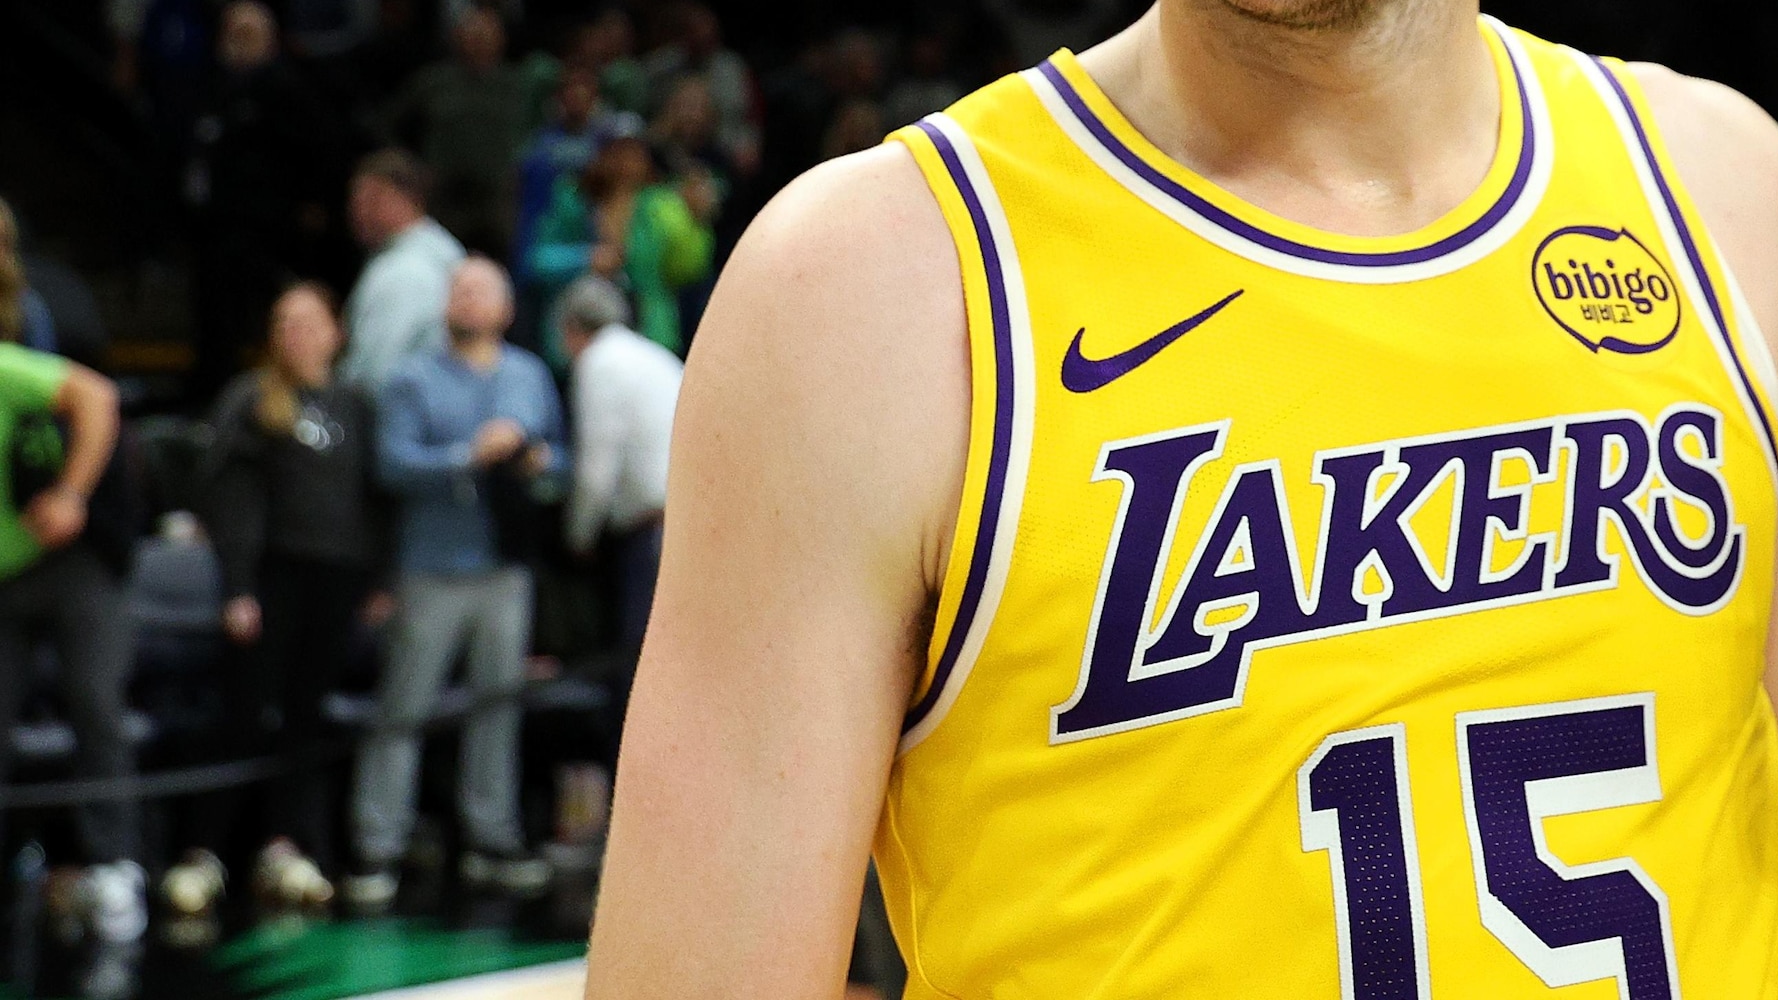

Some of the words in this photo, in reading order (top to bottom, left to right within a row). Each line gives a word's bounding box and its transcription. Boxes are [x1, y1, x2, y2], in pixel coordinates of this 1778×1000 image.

[1543, 258, 1669, 315] bibigo
[1579, 304, 1635, 324] 비비고
[1048, 402, 1746, 746] LAKERS
[1297, 692, 1686, 1000] 15
